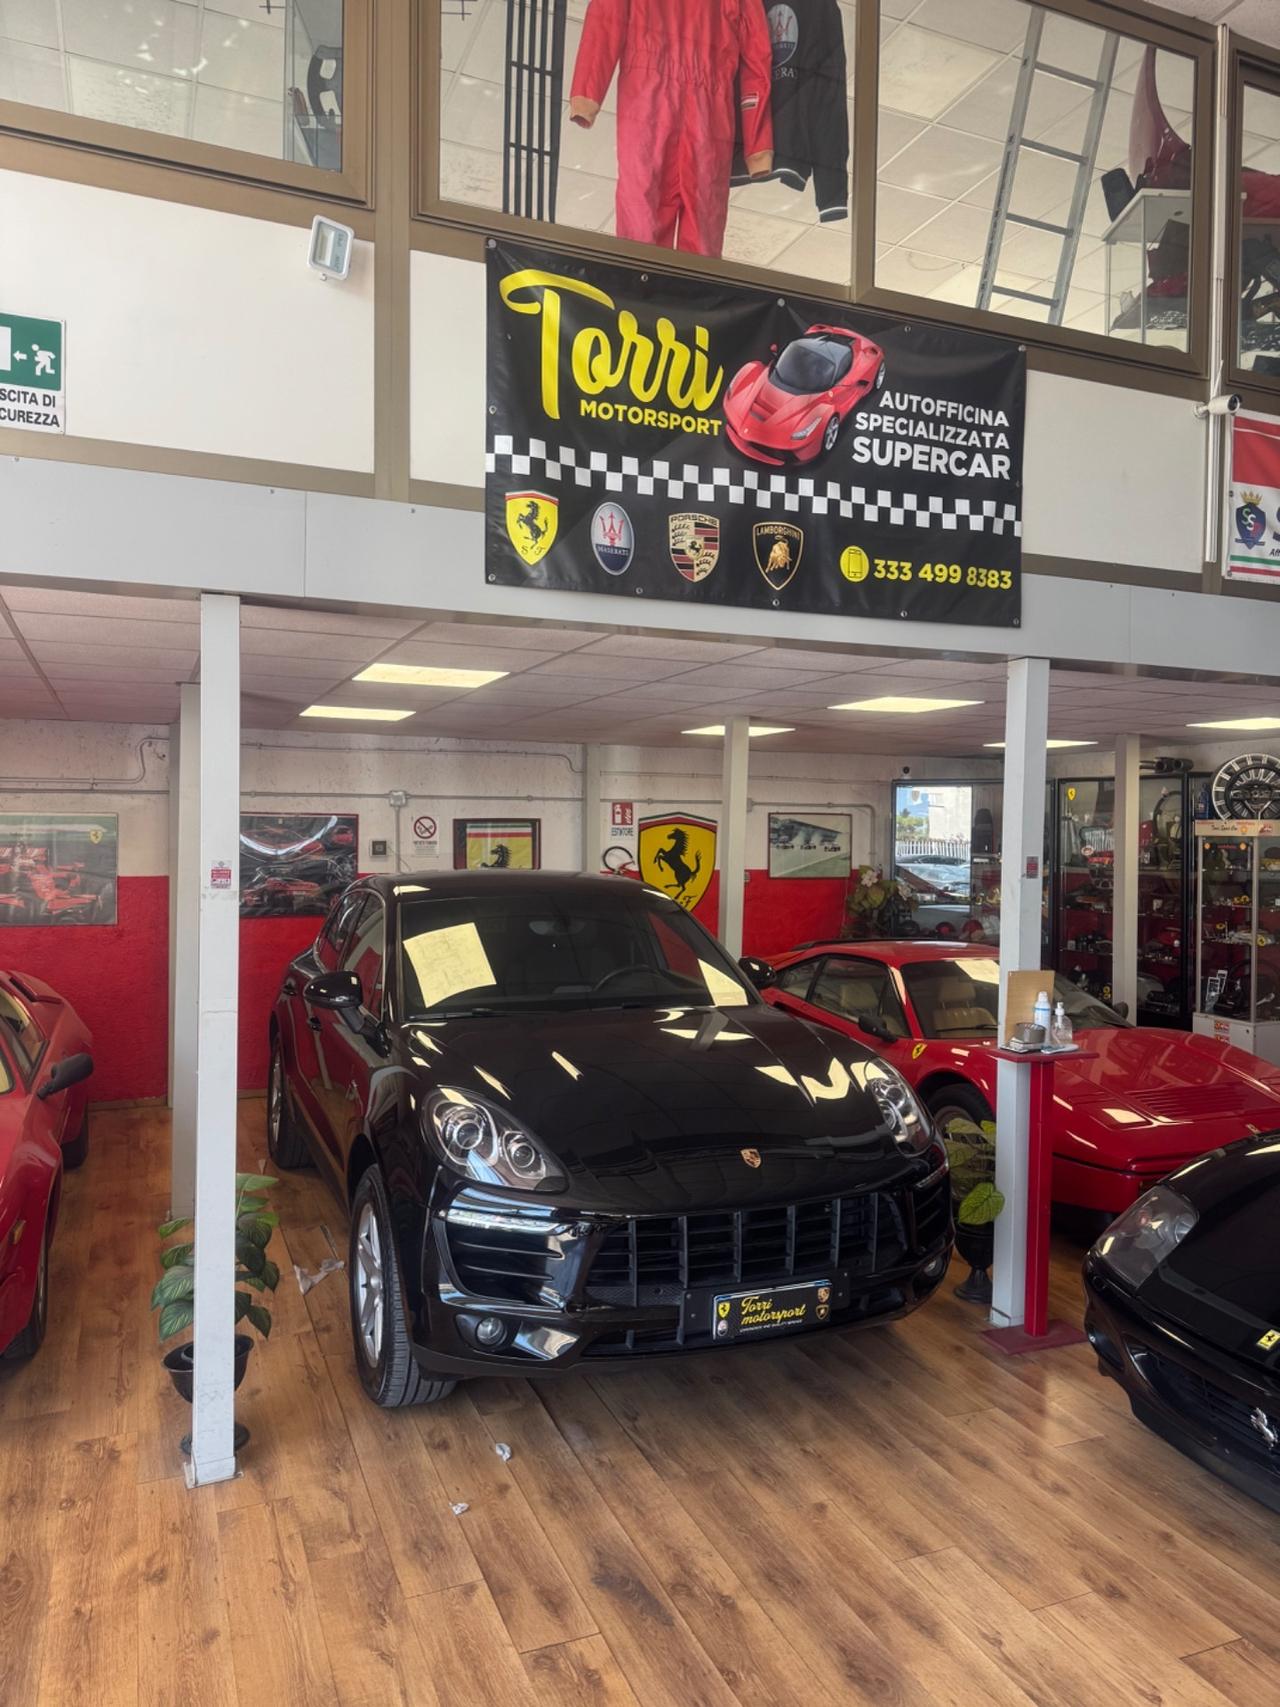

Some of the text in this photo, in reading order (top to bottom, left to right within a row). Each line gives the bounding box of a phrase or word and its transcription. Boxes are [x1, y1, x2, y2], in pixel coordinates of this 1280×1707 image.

[500, 269, 724, 420] Torri
[0, 388, 56, 408] SCITA DI
[879, 390, 1010, 427] AUTOFFICINA
[0, 407, 60, 428] CUREZZA
[580, 400, 722, 436] MOTORSPORT
[855, 412, 1010, 450] SPECIALIZZATA
[852, 436, 1011, 480] SUPERCAR
[671, 513, 719, 527] PORSCHE
[756, 525, 801, 539] LAMBORGHINI
[873, 558, 1013, 590] 333 499 8383
[740, 1304, 807, 1326] motorsport
[741, 1296, 773, 1315] Torri
